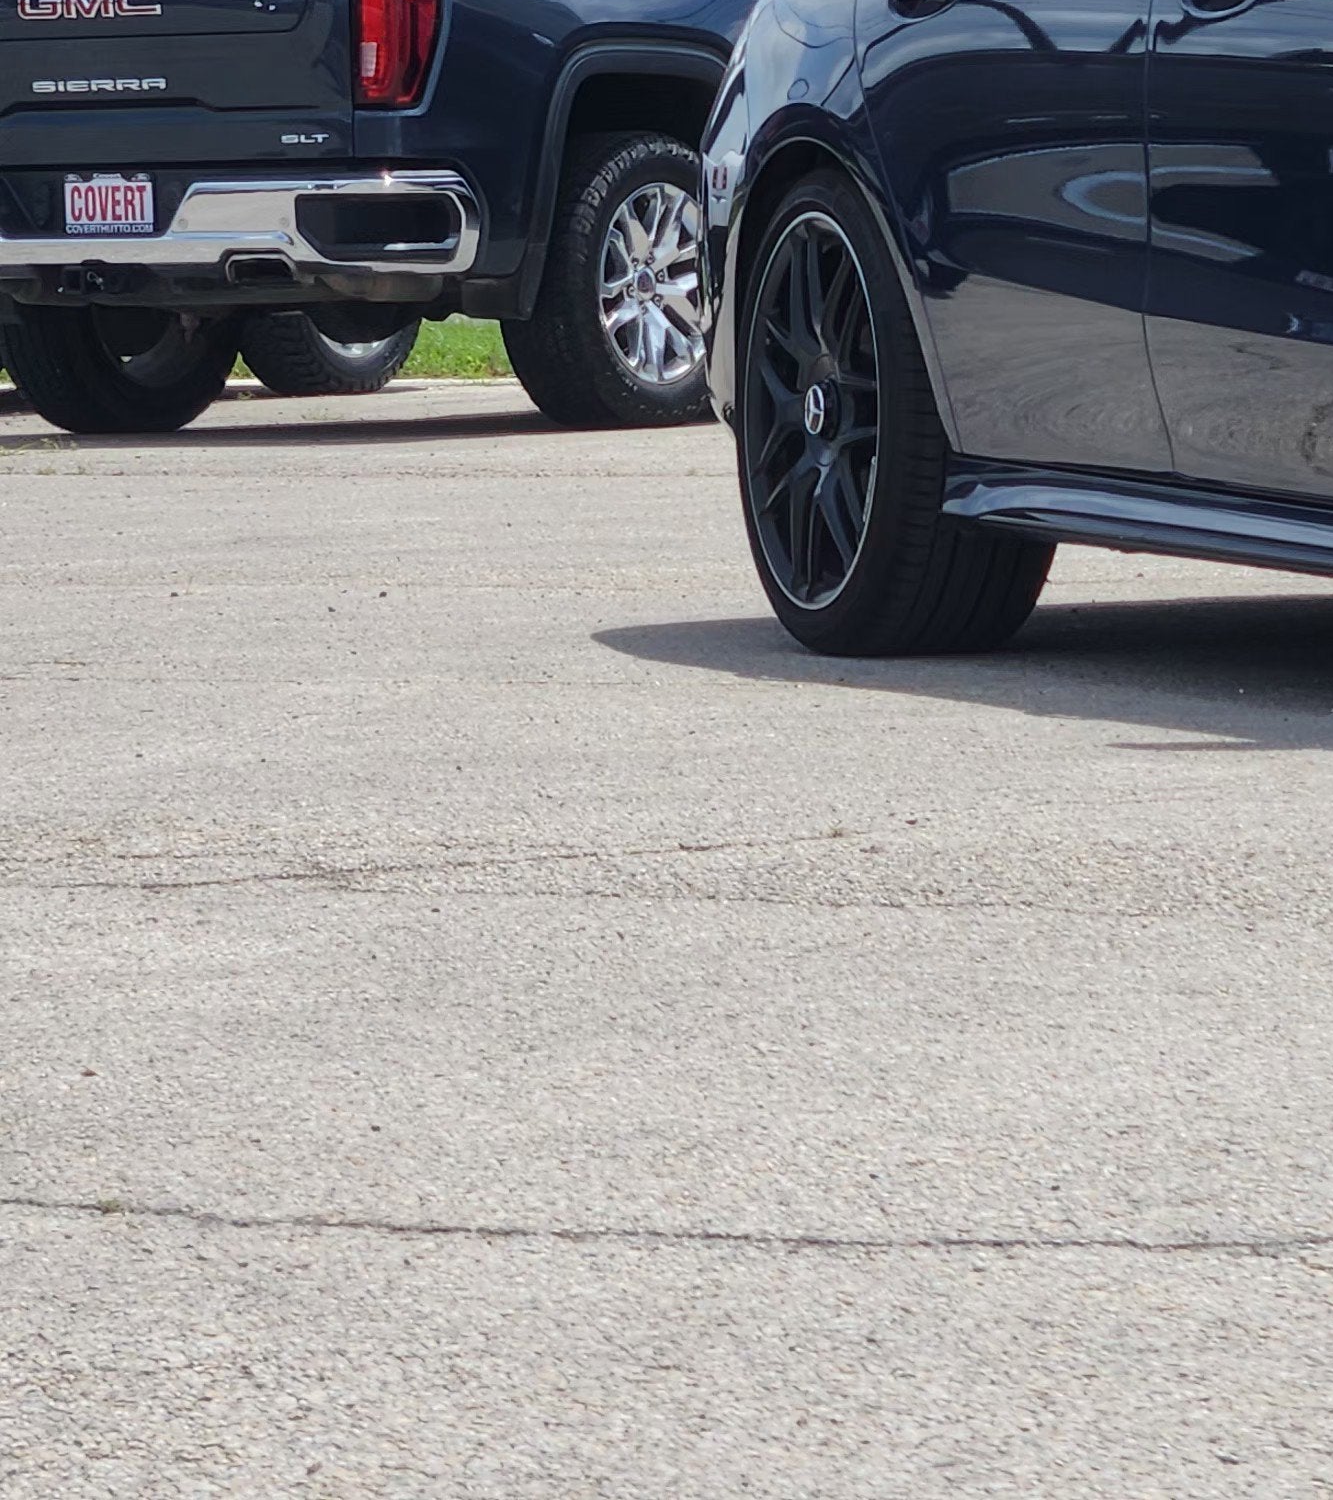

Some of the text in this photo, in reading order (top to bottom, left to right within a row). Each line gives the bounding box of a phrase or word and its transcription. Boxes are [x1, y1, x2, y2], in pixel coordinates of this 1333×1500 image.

[32, 77, 167, 93] SIERRA
[281, 133, 330, 145] SLT
[71, 185, 146, 222] COVERT
[66, 224, 153, 234] COVERTHUTTO.COM
